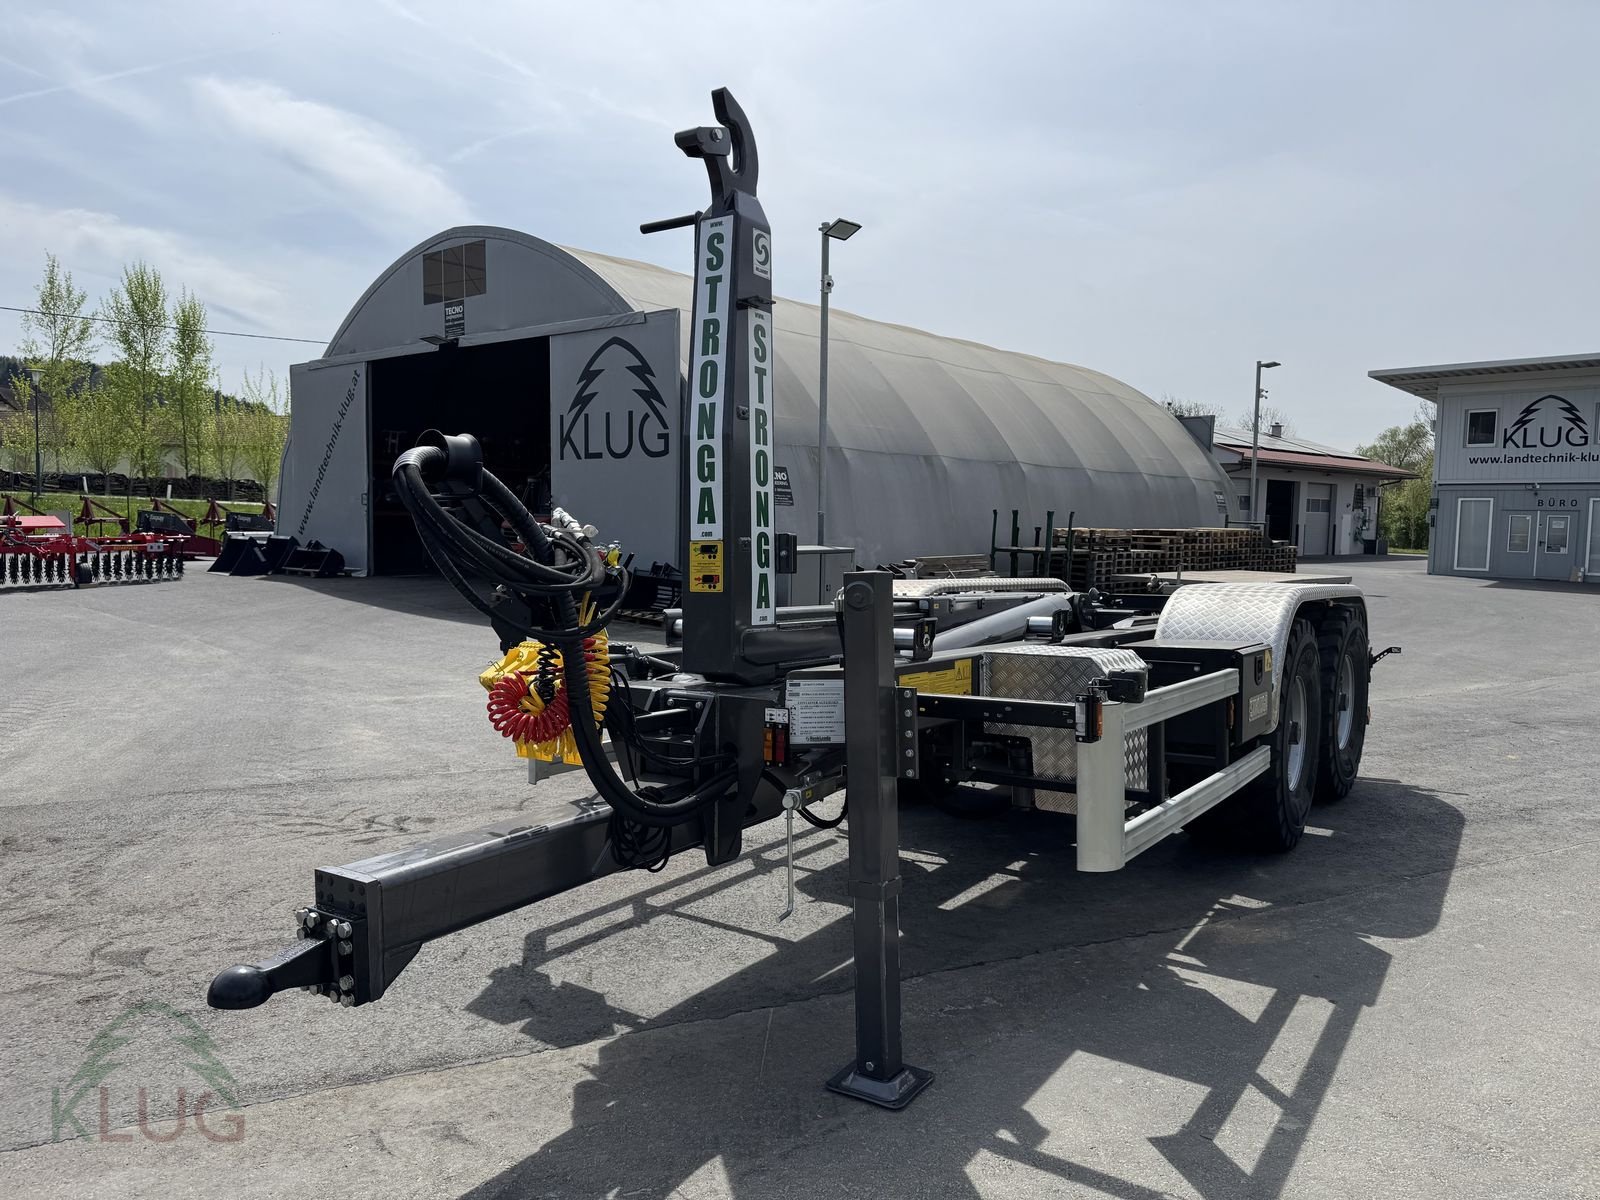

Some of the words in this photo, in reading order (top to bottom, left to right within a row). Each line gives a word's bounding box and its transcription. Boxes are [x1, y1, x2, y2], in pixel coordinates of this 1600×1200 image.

[445, 305, 463, 315] TECNO
[696, 232, 725, 525] STRONGA
[299, 369, 361, 535] www.landtechnik-klug.at
[560, 410, 669, 460] KLUG
[1502, 426, 1589, 449] KLUG
[753, 324, 771, 609] STRONGA
[1469, 451, 1600, 464] www.landtechnik-klu
[1537, 498, 1578, 507] BÜRO
